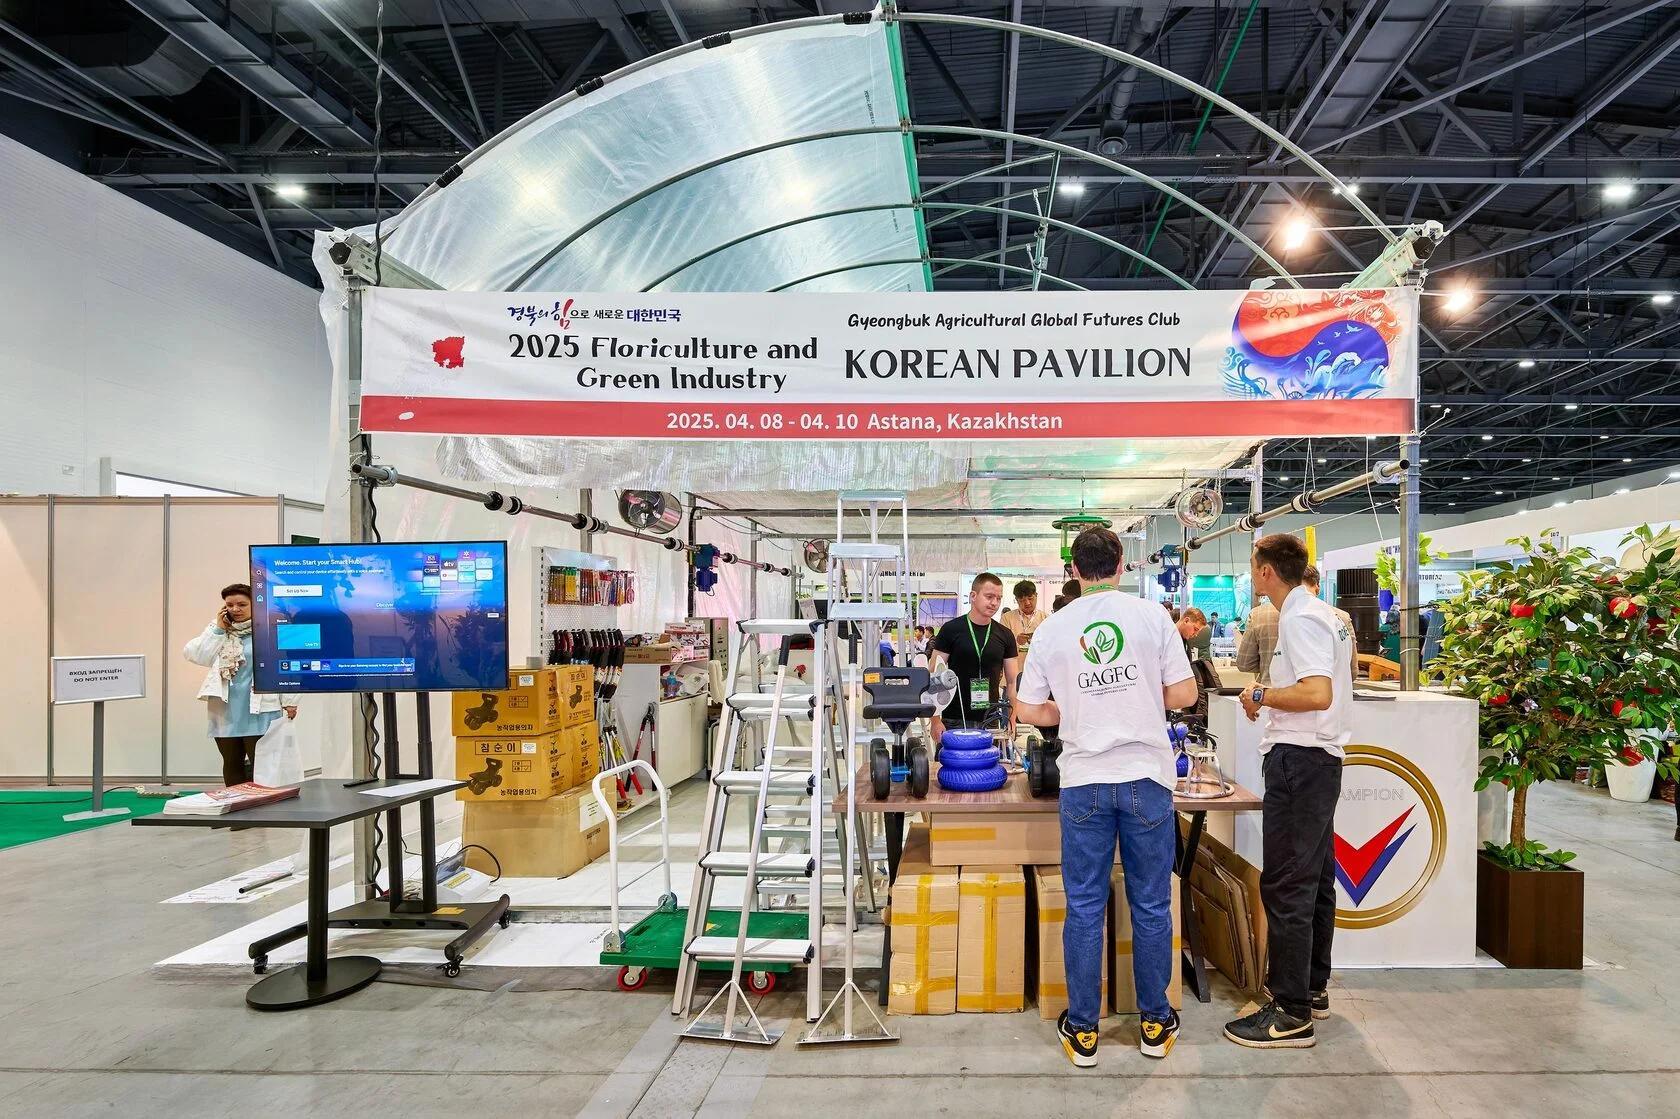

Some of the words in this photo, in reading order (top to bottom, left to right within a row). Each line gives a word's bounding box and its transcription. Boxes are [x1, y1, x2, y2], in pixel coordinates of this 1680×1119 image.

[507, 305, 549, 327] 경북의
[594, 309, 624, 320] 새로운
[627, 308, 681, 322] 대한민국
[848, 313, 930, 331] Gyeongbuk
[935, 312, 1026, 330] Agricultural
[1031, 312, 1078, 327] Global
[1083, 312, 1144, 327] Futures
[1149, 312, 1181, 326] Club
[509, 334, 580, 358] 2025
[592, 336, 758, 359] Floriculture
[767, 336, 818, 359] and
[845, 349, 1000, 379] KOREAN
[1012, 348, 1191, 378] PAVILION
[577, 367, 660, 389] Green
[671, 366, 787, 393] Industry
[667, 412, 720, 430] 2025.
[725, 413, 755, 430] 04.
[760, 413, 783, 430] 08
[800, 413, 830, 430] 04.
[836, 413, 859, 430] 10
[867, 413, 942, 433] Astana,
[947, 412, 1063, 430] Kazakhstan
[1078, 664, 1138, 689] GAGFC
[1339, 788, 1404, 801] AMPION
